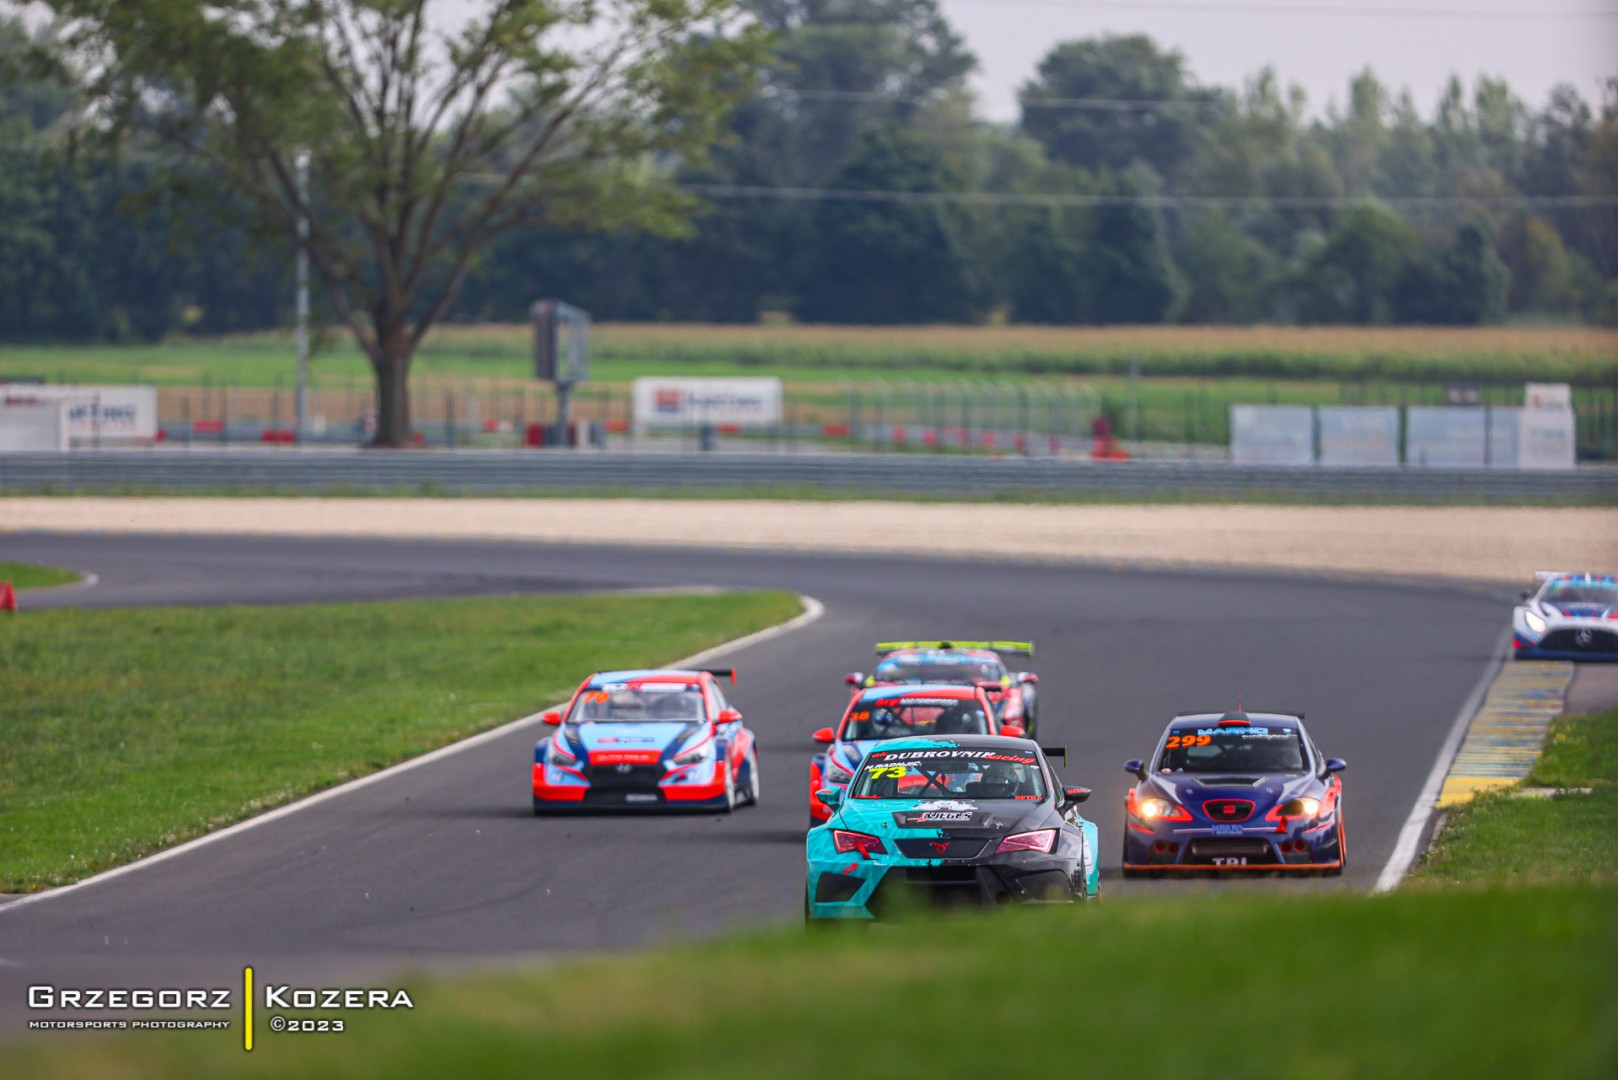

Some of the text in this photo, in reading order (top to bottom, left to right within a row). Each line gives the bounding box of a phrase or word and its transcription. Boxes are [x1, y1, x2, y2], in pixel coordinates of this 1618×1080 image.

[1165, 734, 1212, 749] 299
[884, 750, 996, 761] DUBROVNIK
[868, 766, 907, 780] 73
